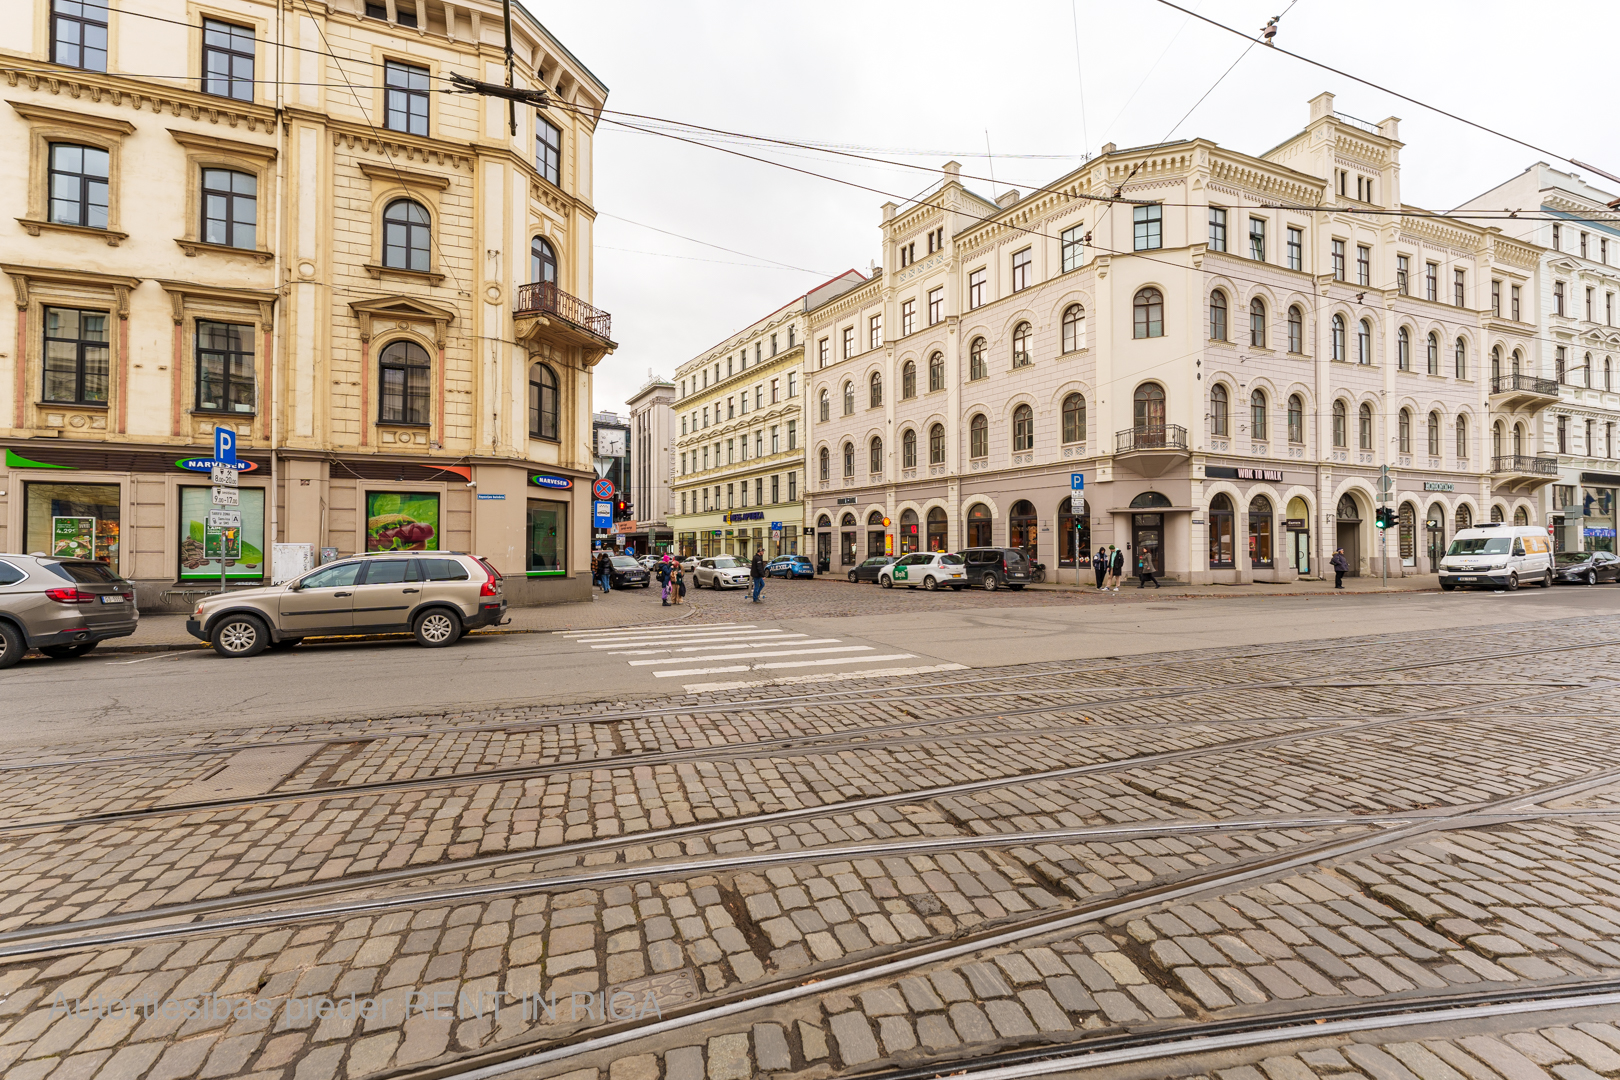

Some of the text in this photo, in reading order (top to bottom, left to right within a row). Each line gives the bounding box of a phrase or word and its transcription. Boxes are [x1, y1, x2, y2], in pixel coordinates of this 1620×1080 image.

[220, 432, 231, 459] P
[1237, 468, 1282, 481] WOK TO WALK
[539, 477, 567, 486] NARVESEN
[1074, 475, 1081, 488] P
